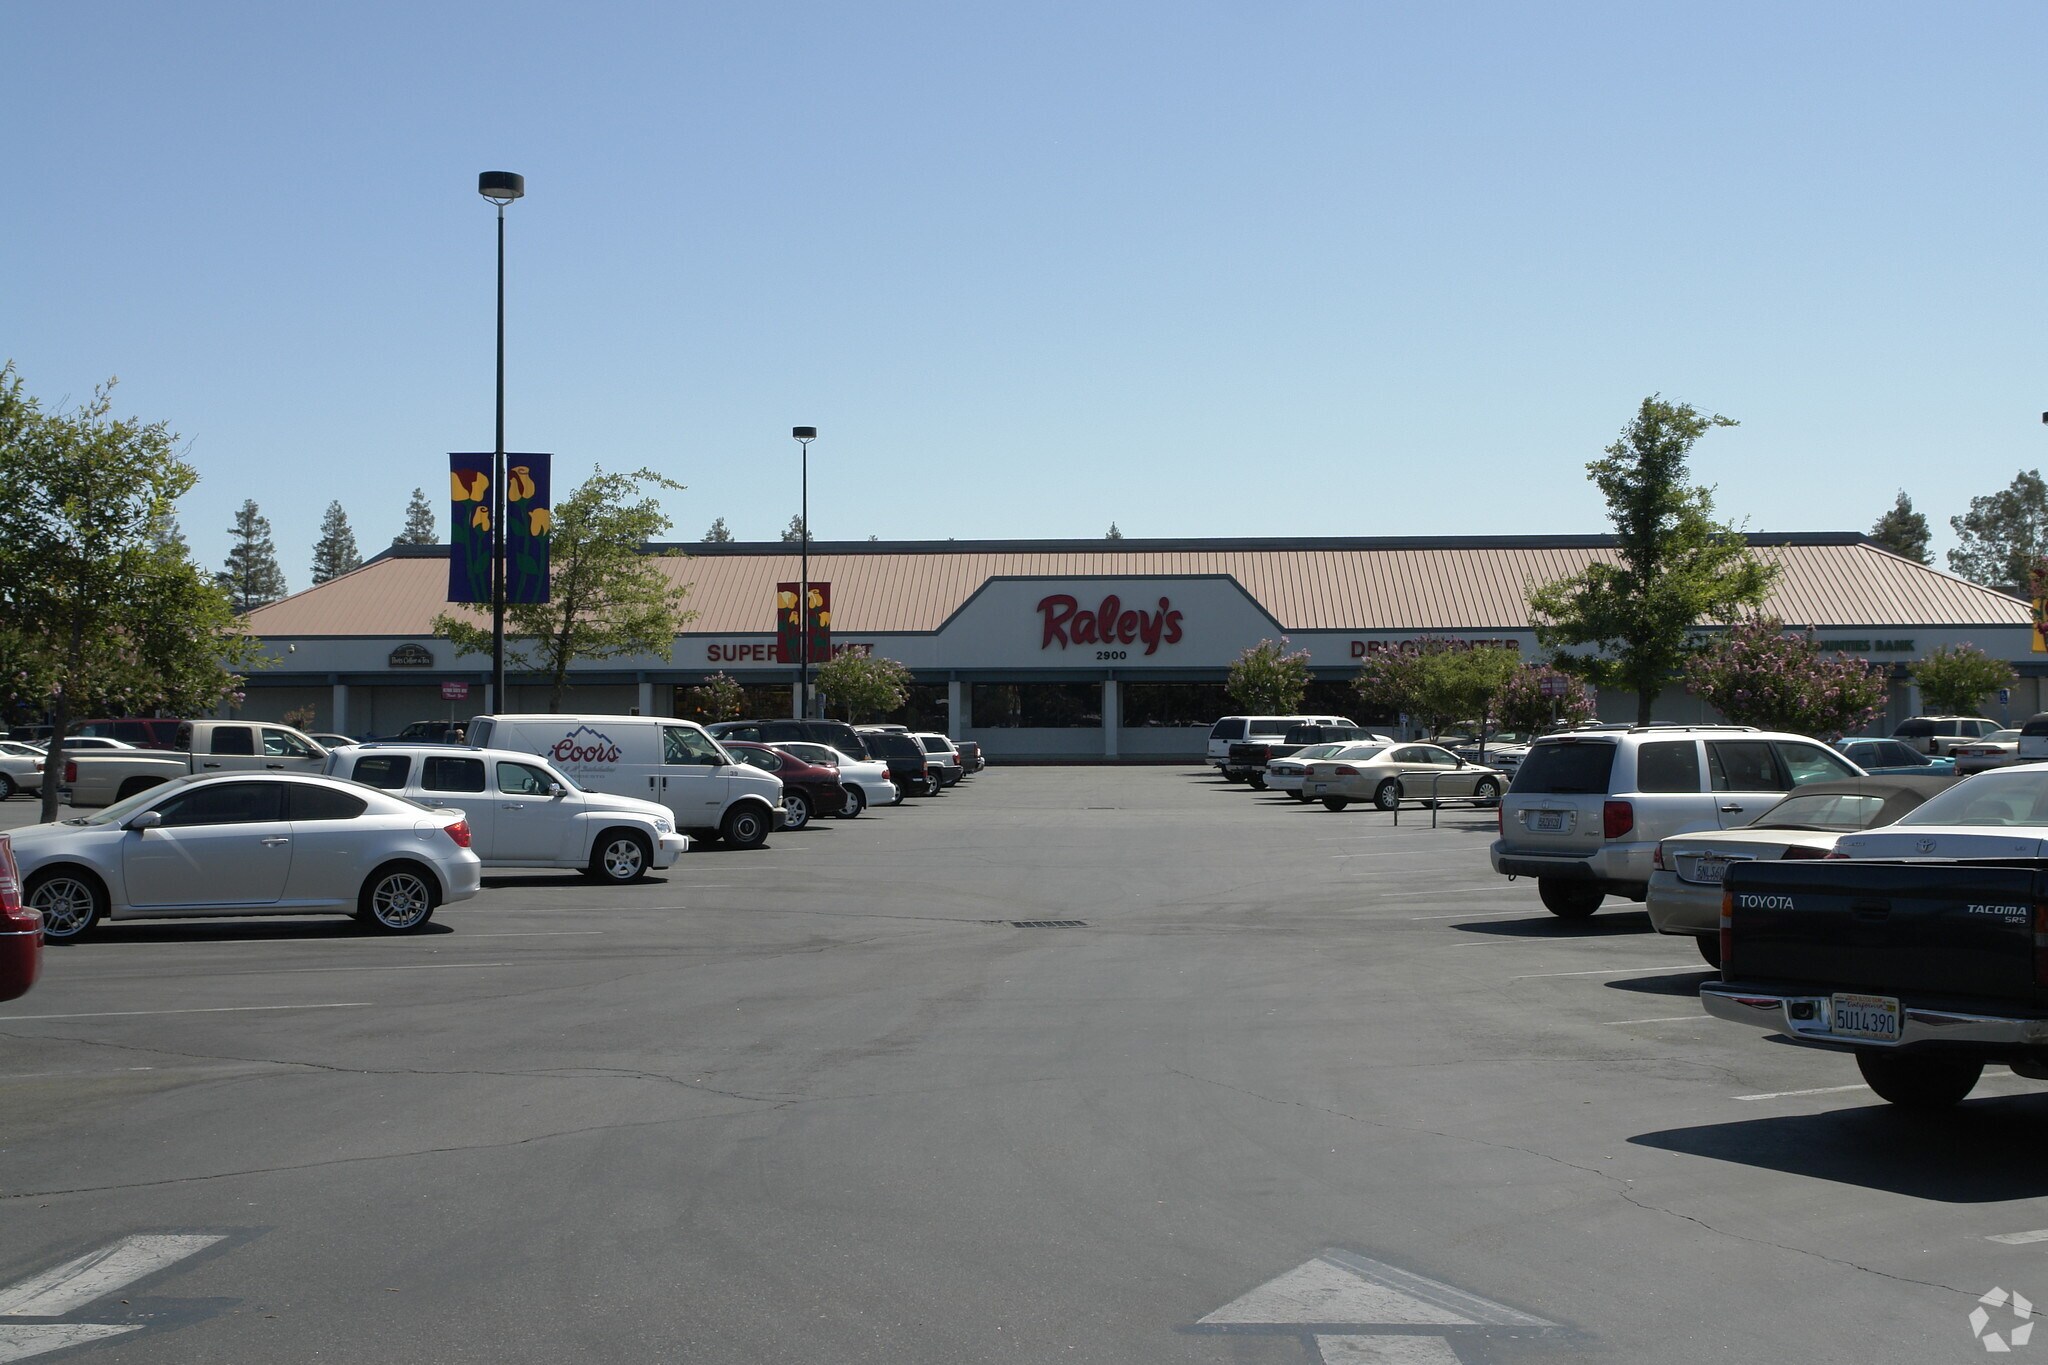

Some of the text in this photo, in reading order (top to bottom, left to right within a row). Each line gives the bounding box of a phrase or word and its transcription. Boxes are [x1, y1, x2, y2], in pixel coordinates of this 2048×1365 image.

[1036, 594, 1184, 656] Raley's
[707, 644, 874, 662] SUPERKT
[1419, 639, 1520, 655] NTR
[1817, 639, 1916, 652] OUNTIES BANK
[1096, 650, 1127, 660] 2900
[552, 738, 620, 763] Coors
[1696, 864, 1726, 879] 5NLS60
[1739, 894, 1795, 911] TOYOTA
[1967, 903, 2028, 916] TACOMA
[1837, 1009, 1895, 1034] 5U14390
